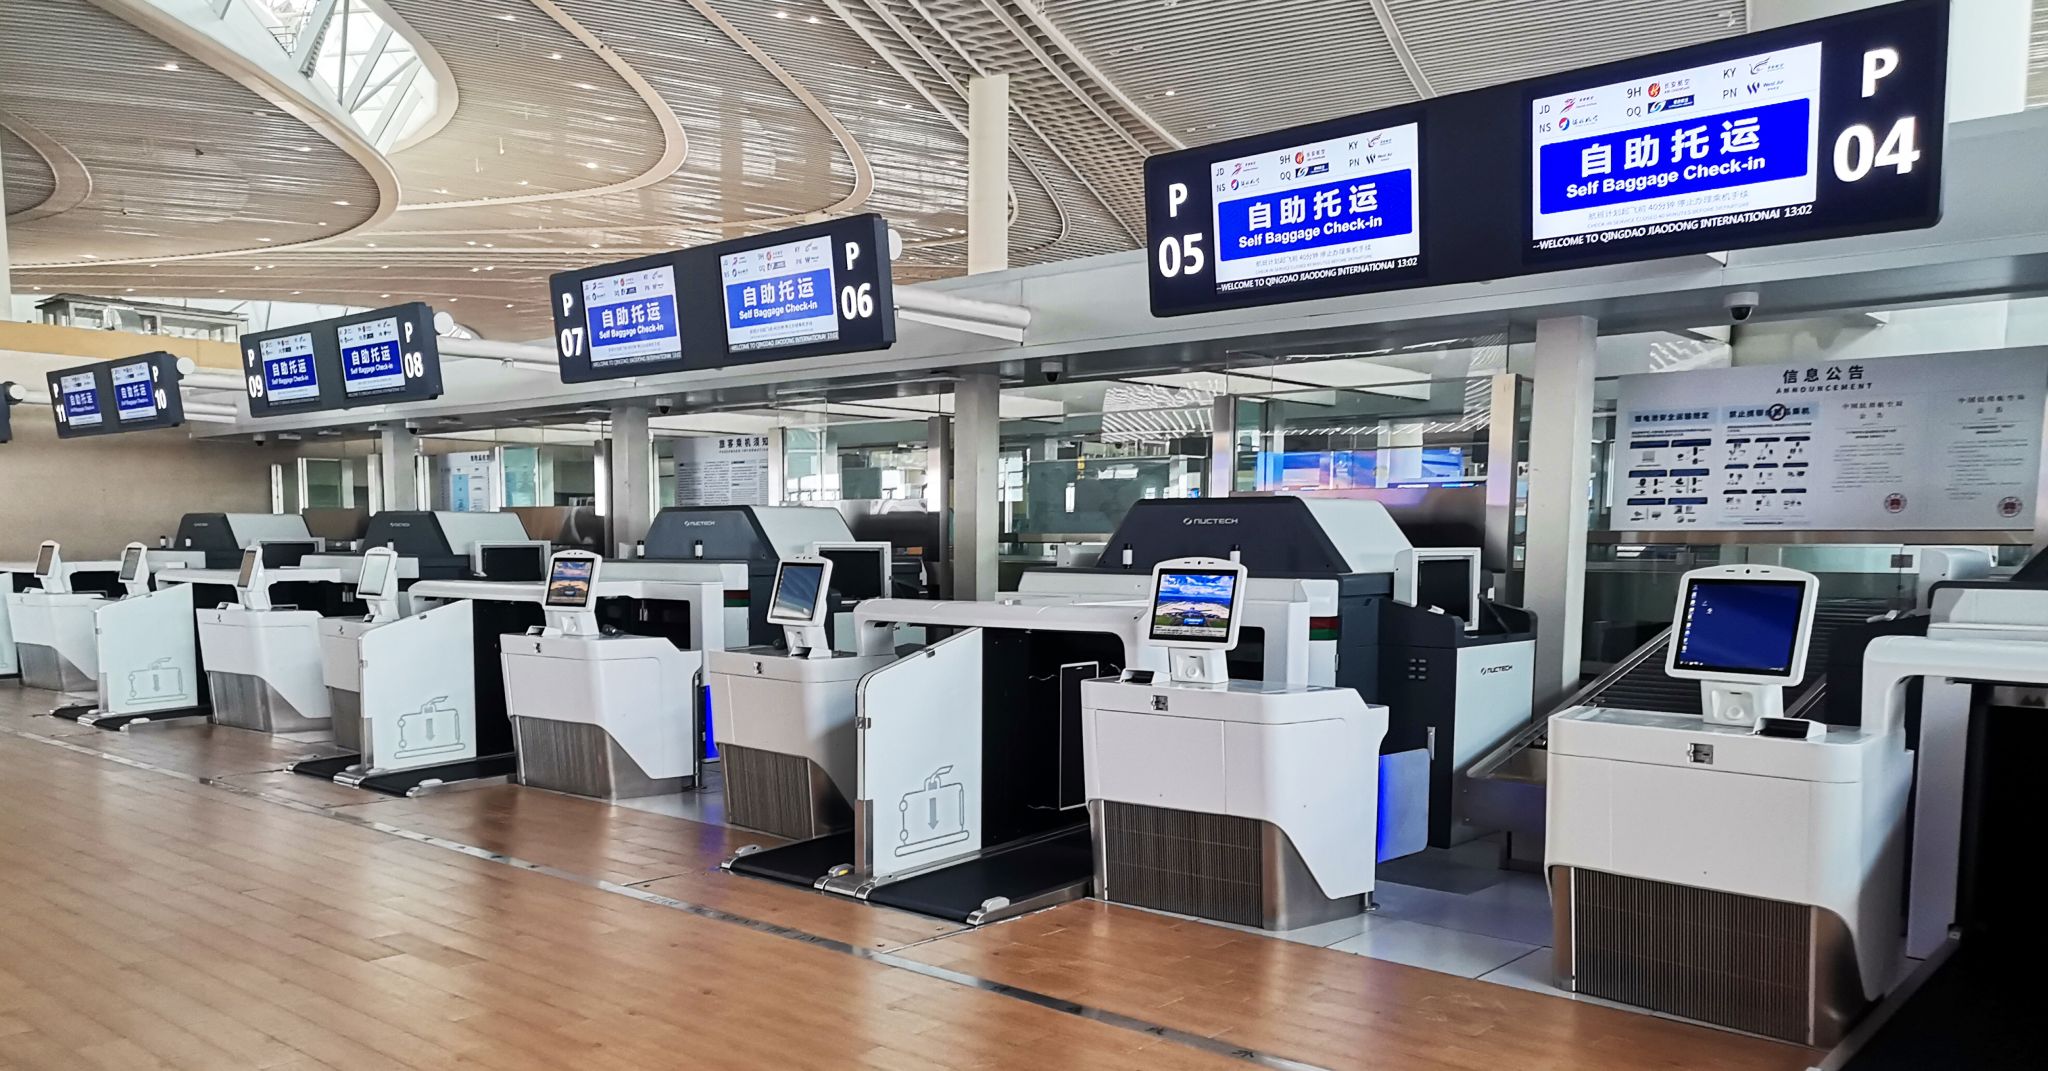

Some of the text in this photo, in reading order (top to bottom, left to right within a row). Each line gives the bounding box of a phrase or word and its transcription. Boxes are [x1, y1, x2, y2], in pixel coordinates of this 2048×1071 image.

[1723, 67, 1736, 79] KY
[1862, 48, 1899, 98] P
[1627, 87, 1642, 98] 9H
[1723, 88, 1737, 99] PN
[1539, 105, 1551, 115] JD
[1539, 123, 1551, 133] NS
[1348, 141, 1358, 150] KY
[1581, 116, 1761, 178] 自助托运
[1833, 116, 1921, 183] 04
[1280, 154, 1291, 164] 9H
[1349, 158, 1359, 167] PN
[1216, 168, 1224, 176] JD
[1566, 155, 1766, 199] Self Baggage Check-in
[1216, 183, 1226, 192] NS
[1169, 183, 1188, 217] P
[1248, 182, 1378, 231] 自助托运
[1238, 216, 1382, 248] Self Baggage Check-in
[1586, 233, 1599, 244] TO
[1600, 227, 1646, 243] QINGDAO
[1647, 219, 1698, 235] JIAODONG
[1784, 204, 1813, 218] 13:02
[845, 242, 859, 271] P
[1159, 232, 1205, 277] 05
[1255, 278, 1264, 287] TO
[1265, 274, 1298, 287] QINGDAO
[1299, 269, 1336, 281] JIAODONG
[1397, 257, 1418, 268] 13:02
[743, 277, 814, 308] 自助托运
[841, 283, 873, 320] 06
[562, 293, 573, 317] P
[602, 302, 661, 328] 自助托运
[739, 301, 817, 320] Self Baggage Check-in
[404, 322, 413, 343] P
[599, 323, 664, 339] Self Baggage Check-in
[561, 327, 583, 358] 07
[247, 349, 255, 367] P
[351, 345, 391, 366] 自助托运
[404, 352, 424, 378] 08
[152, 366, 159, 382] P
[1783, 364, 1864, 384] 信息公告
[248, 375, 264, 398] 09
[1776, 382, 1872, 394] ANNOUNCEMENT
[155, 389, 167, 409] 10
[56, 404, 66, 422] 11
[1487, 665, 1513, 674] NUCTECH
